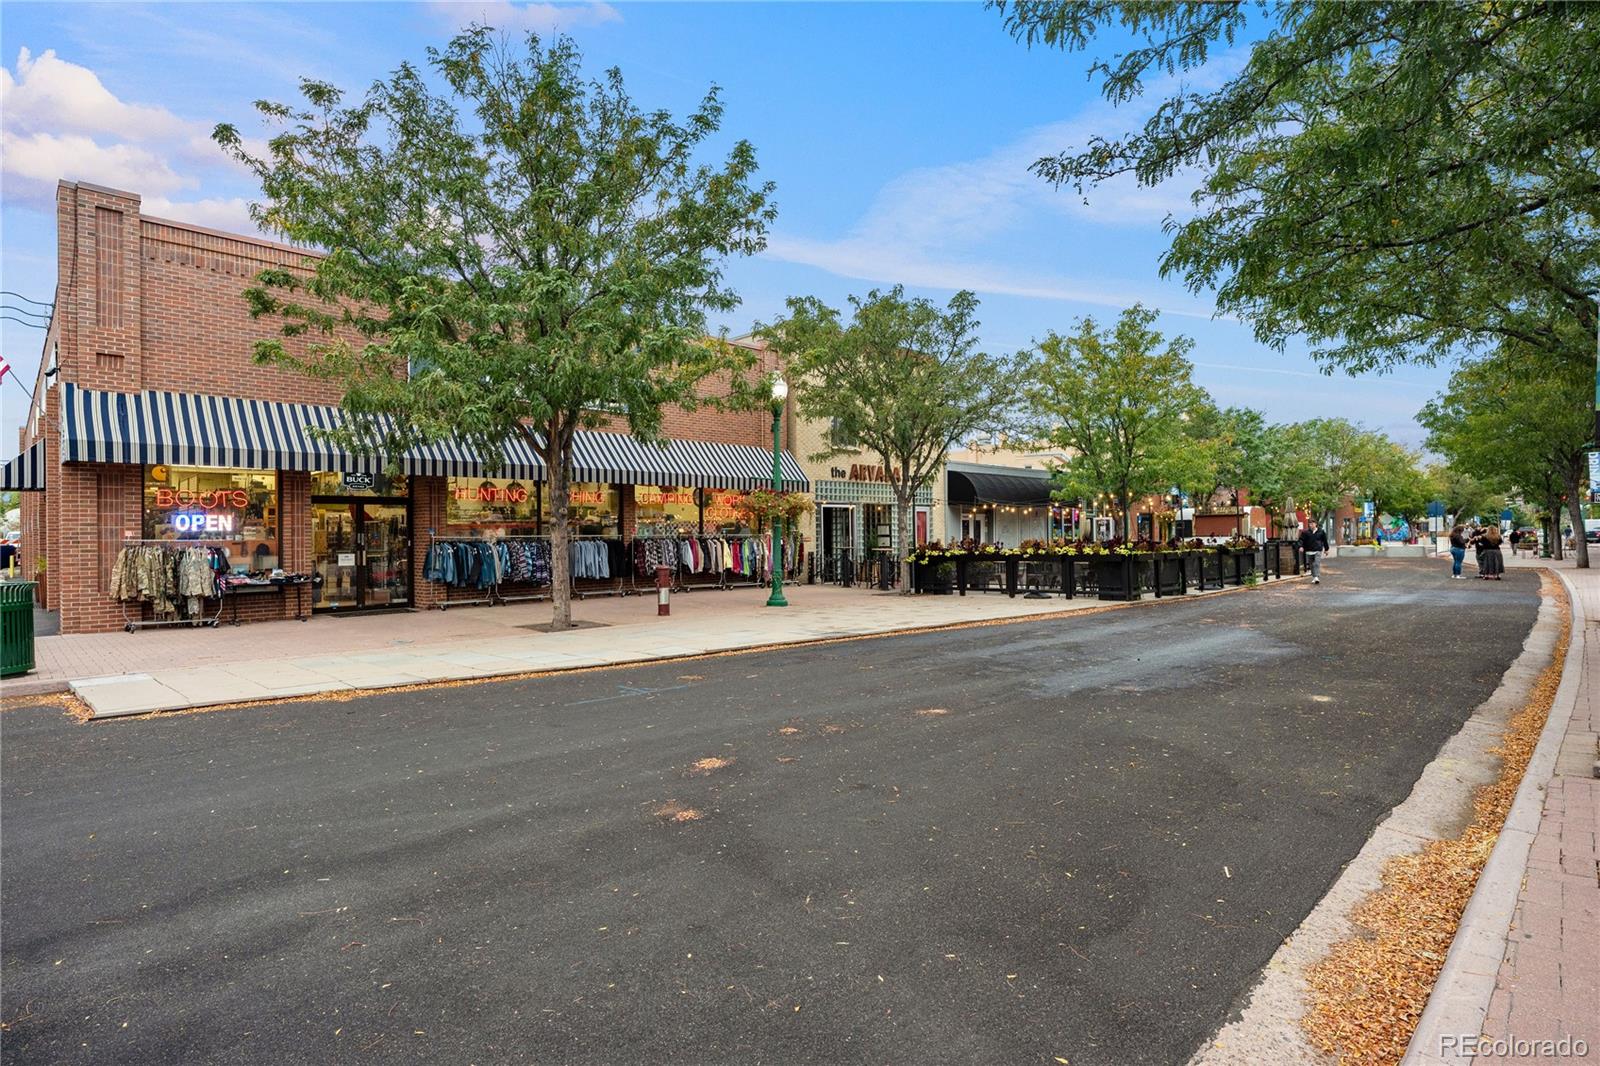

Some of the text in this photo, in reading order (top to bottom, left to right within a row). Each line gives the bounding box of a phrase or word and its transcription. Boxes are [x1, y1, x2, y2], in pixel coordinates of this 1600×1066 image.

[831, 467, 846, 479] the
[156, 489, 248, 509] BOOTS
[455, 487, 529, 503] HUNTING
[640, 492, 694, 505] CAMPING
[175, 514, 232, 531] OPEN
